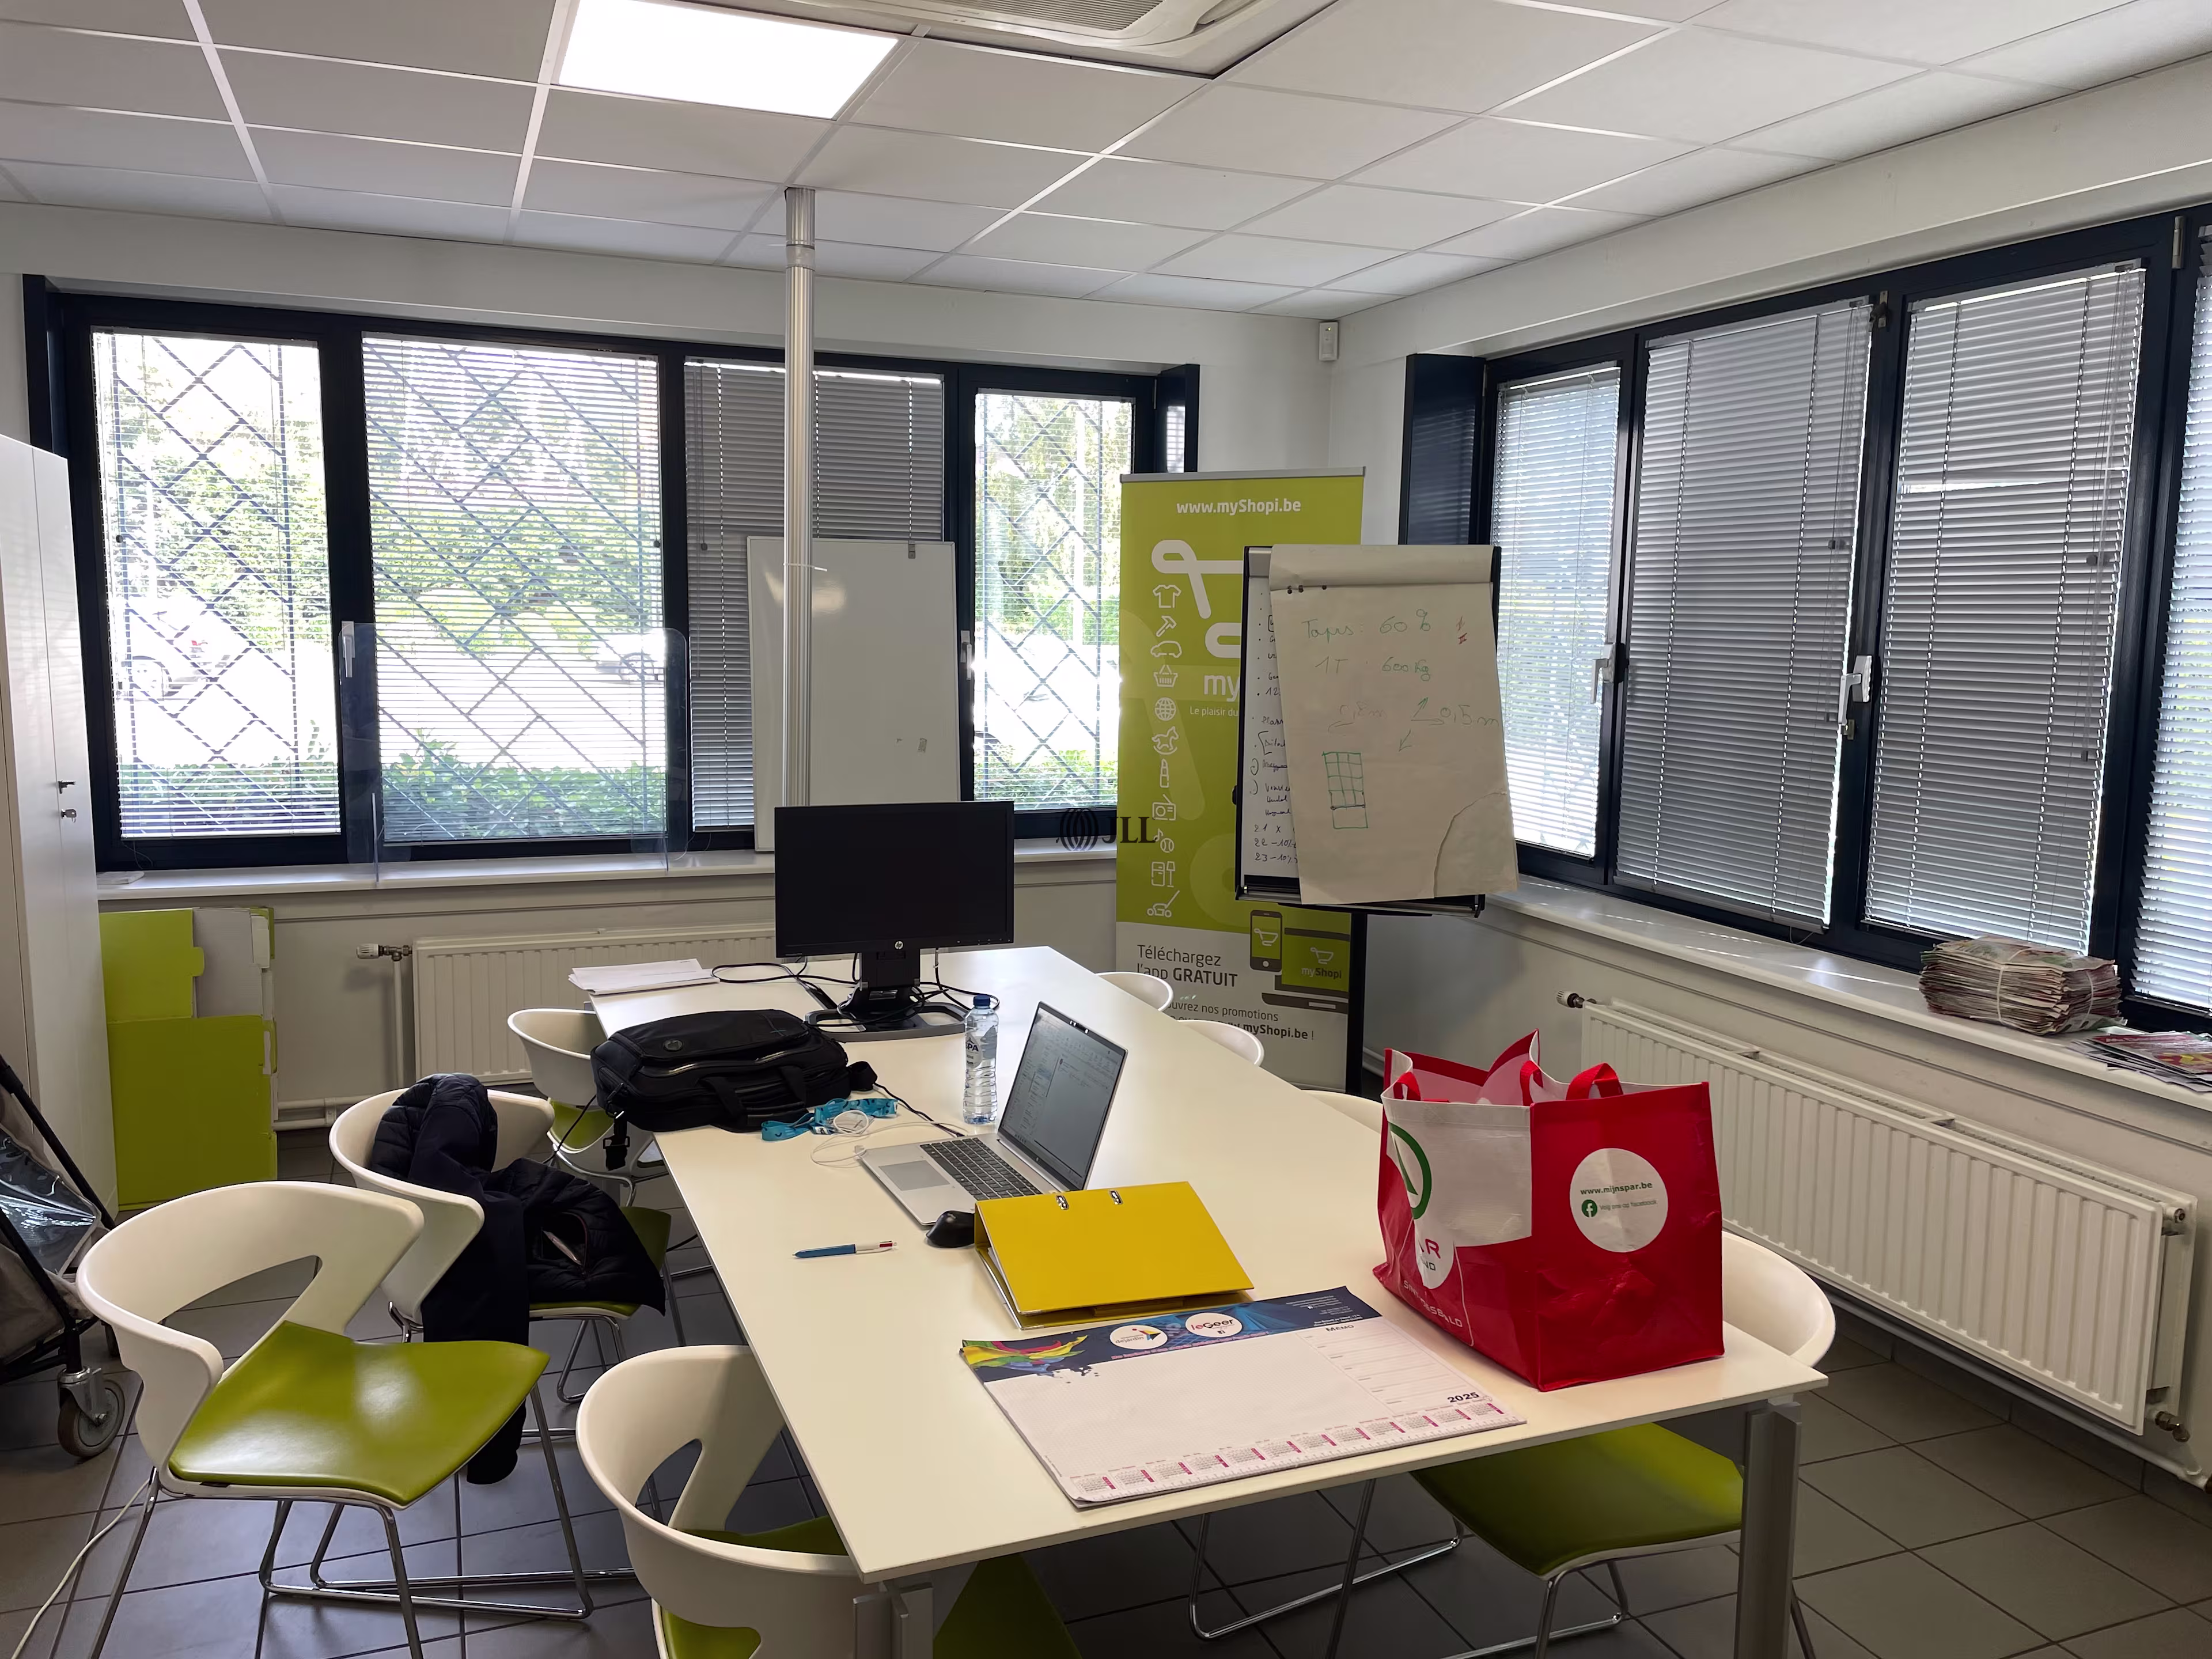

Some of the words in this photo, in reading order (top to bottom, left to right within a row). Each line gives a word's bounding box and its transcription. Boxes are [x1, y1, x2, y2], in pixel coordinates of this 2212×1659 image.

[1176, 498, 1301, 516] www.myShopi.be
[1204, 675, 1240, 702] my
[1190, 706, 1200, 715] Le
[1201, 707, 1226, 717] plaisir
[1137, 944, 1221, 968] Téléchargez
[1173, 967, 1238, 987] GRATUIT
[1301, 967, 1342, 980] myShopi
[1202, 1005, 1219, 1014] nos
[1222, 1007, 1279, 1021] promotions
[1580, 1182, 1653, 1195] www.mijnspar.be
[1115, 1335, 1145, 1344] dejardin
[1447, 1392, 1480, 1403] 2025
